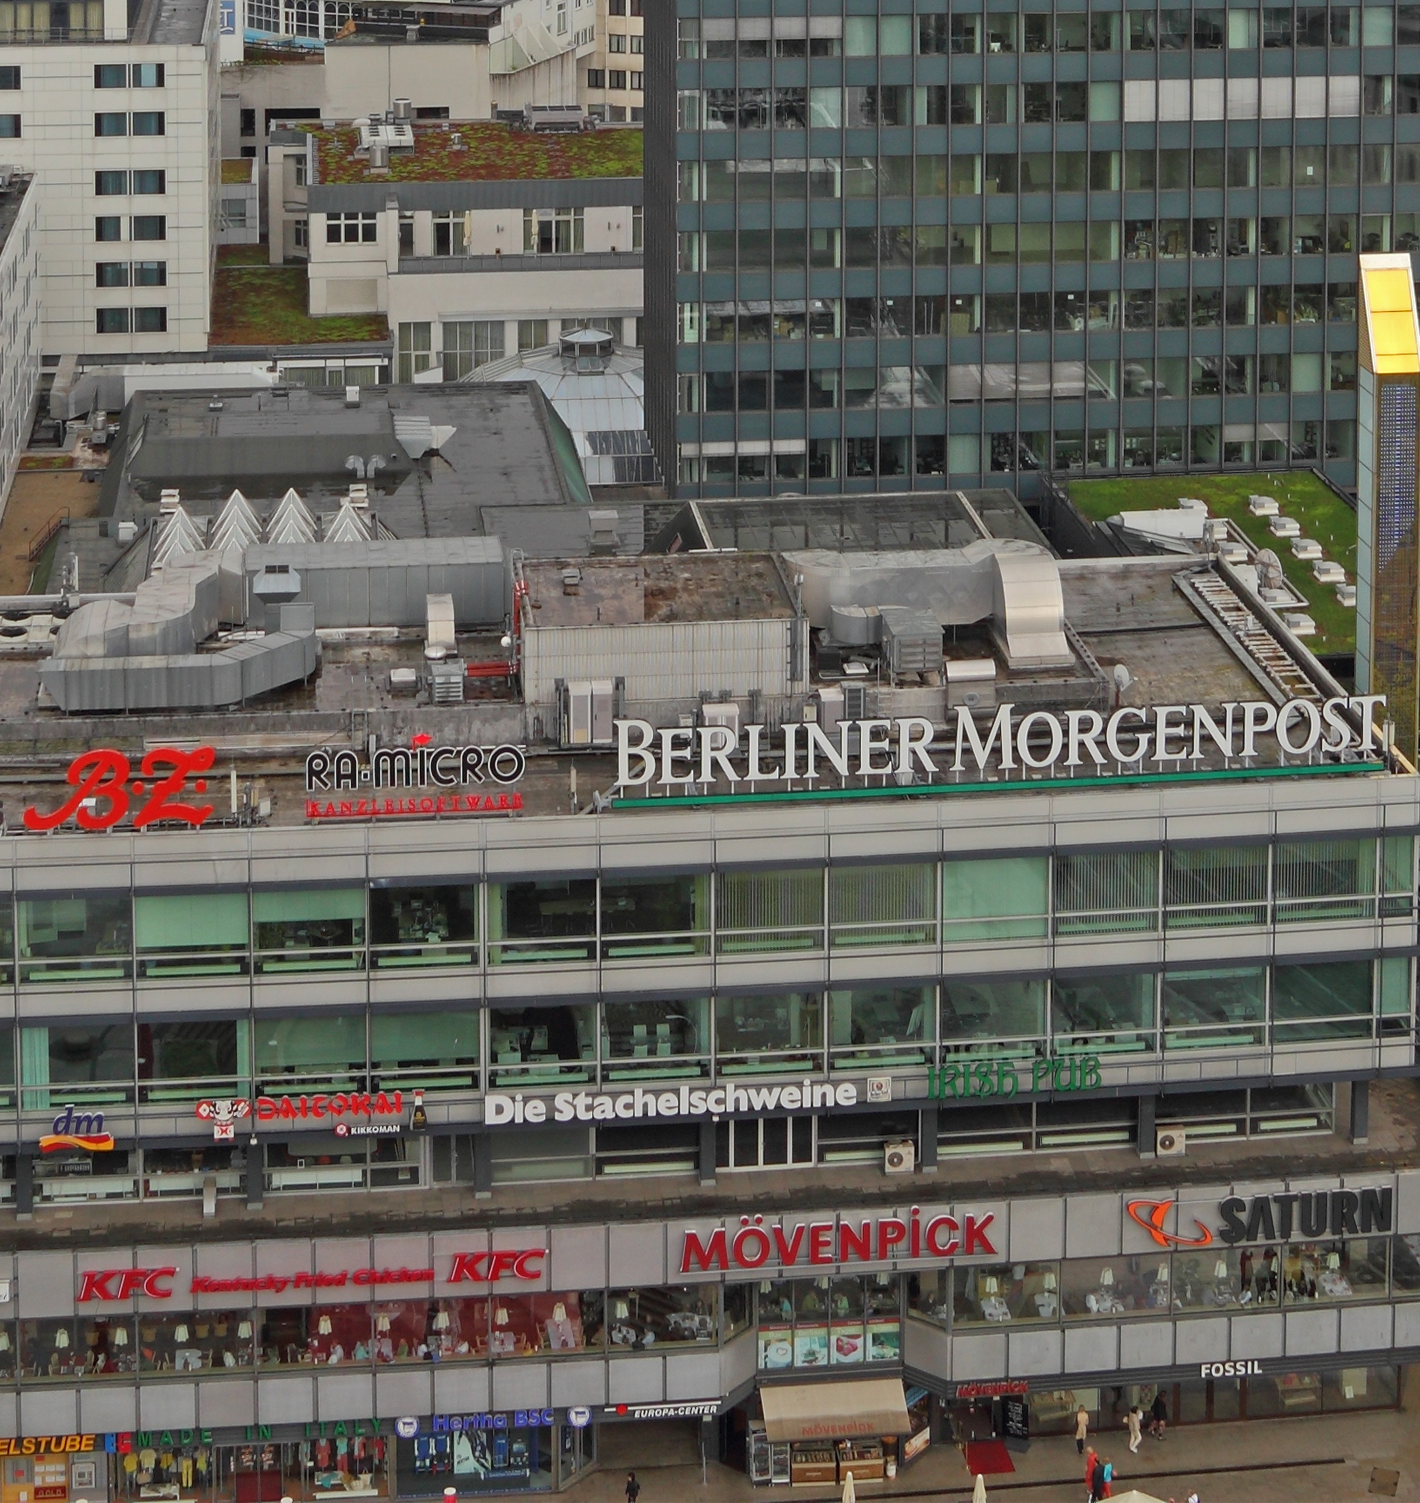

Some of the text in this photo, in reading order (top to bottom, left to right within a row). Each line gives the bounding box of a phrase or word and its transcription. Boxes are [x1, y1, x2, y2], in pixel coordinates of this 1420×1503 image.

[613, 694, 1389, 787] BERLINER MORGENPOST
[304, 792, 524, 819] KANZLEISOFTWARE
[1032, 1055, 1104, 1094] PUB
[256, 1090, 403, 1121] DAITOKAI
[483, 1078, 858, 1126] Die Stachelschweine
[52, 1104, 106, 1137] dm
[350, 1124, 401, 1135] KIKKOMAN
[1218, 1185, 1393, 1245] SATURN
[76, 1248, 547, 1302] KFC Kentucky Fried Chicken KFC
[1201, 1360, 1263, 1378] FOSSIL
[137, 1419, 382, 1448] MADE IN ITALY
[433, 1408, 555, 1432] Hertha BSC
